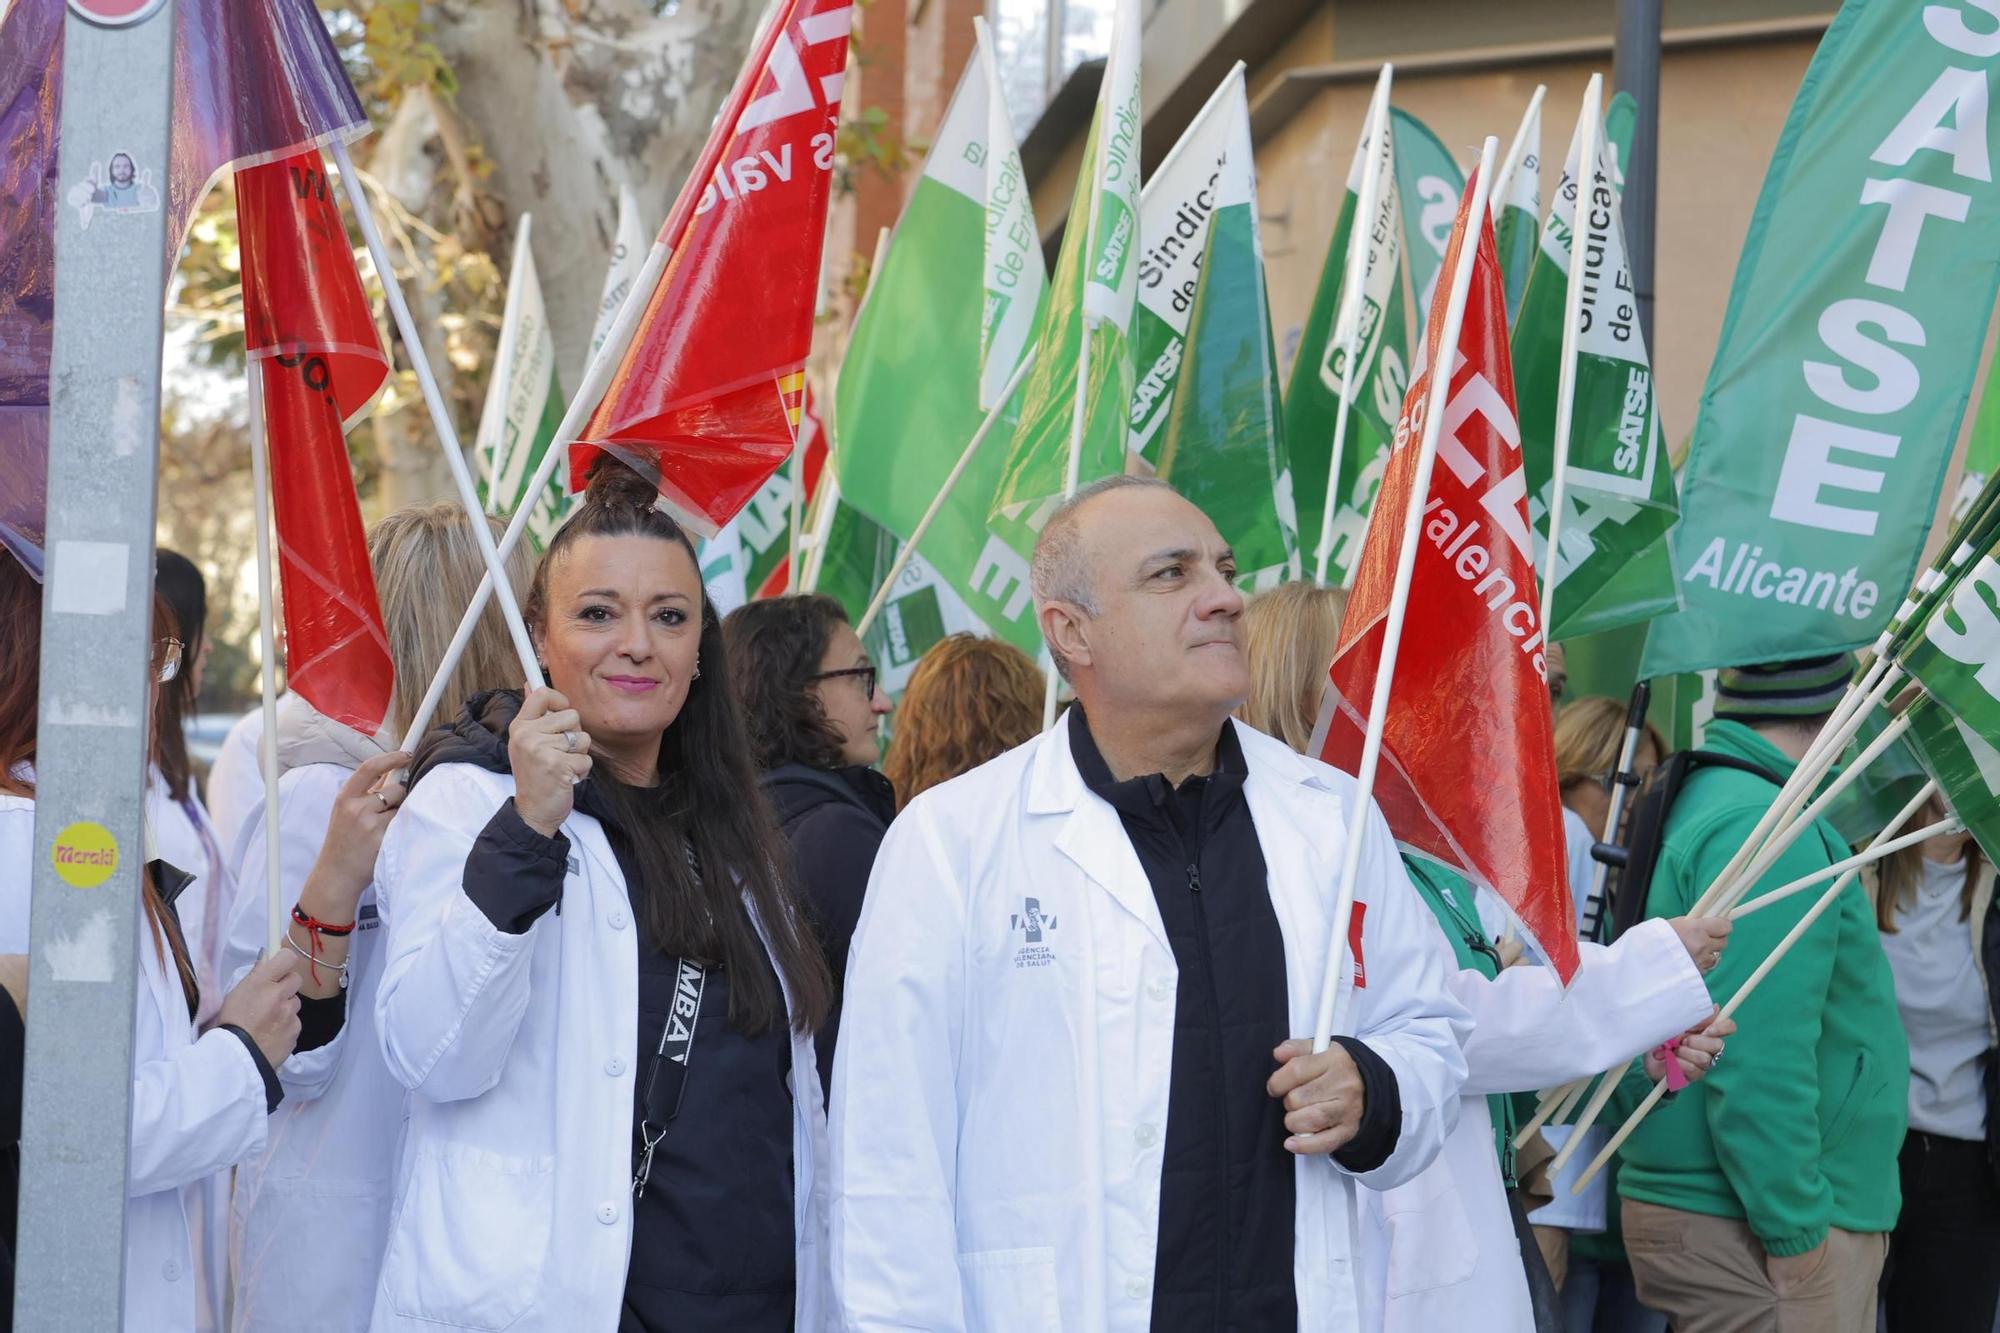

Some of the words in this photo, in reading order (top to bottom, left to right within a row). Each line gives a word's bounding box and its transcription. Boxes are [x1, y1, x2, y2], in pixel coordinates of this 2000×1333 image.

[1096, 208, 1132, 281] SATSE
[1769, 0, 2000, 536] SATSE
[1171, 280, 1195, 313] de
[1608, 304, 1633, 342] de
[1613, 366, 1649, 473] SATSE
[1683, 536, 1879, 620] Alicante
